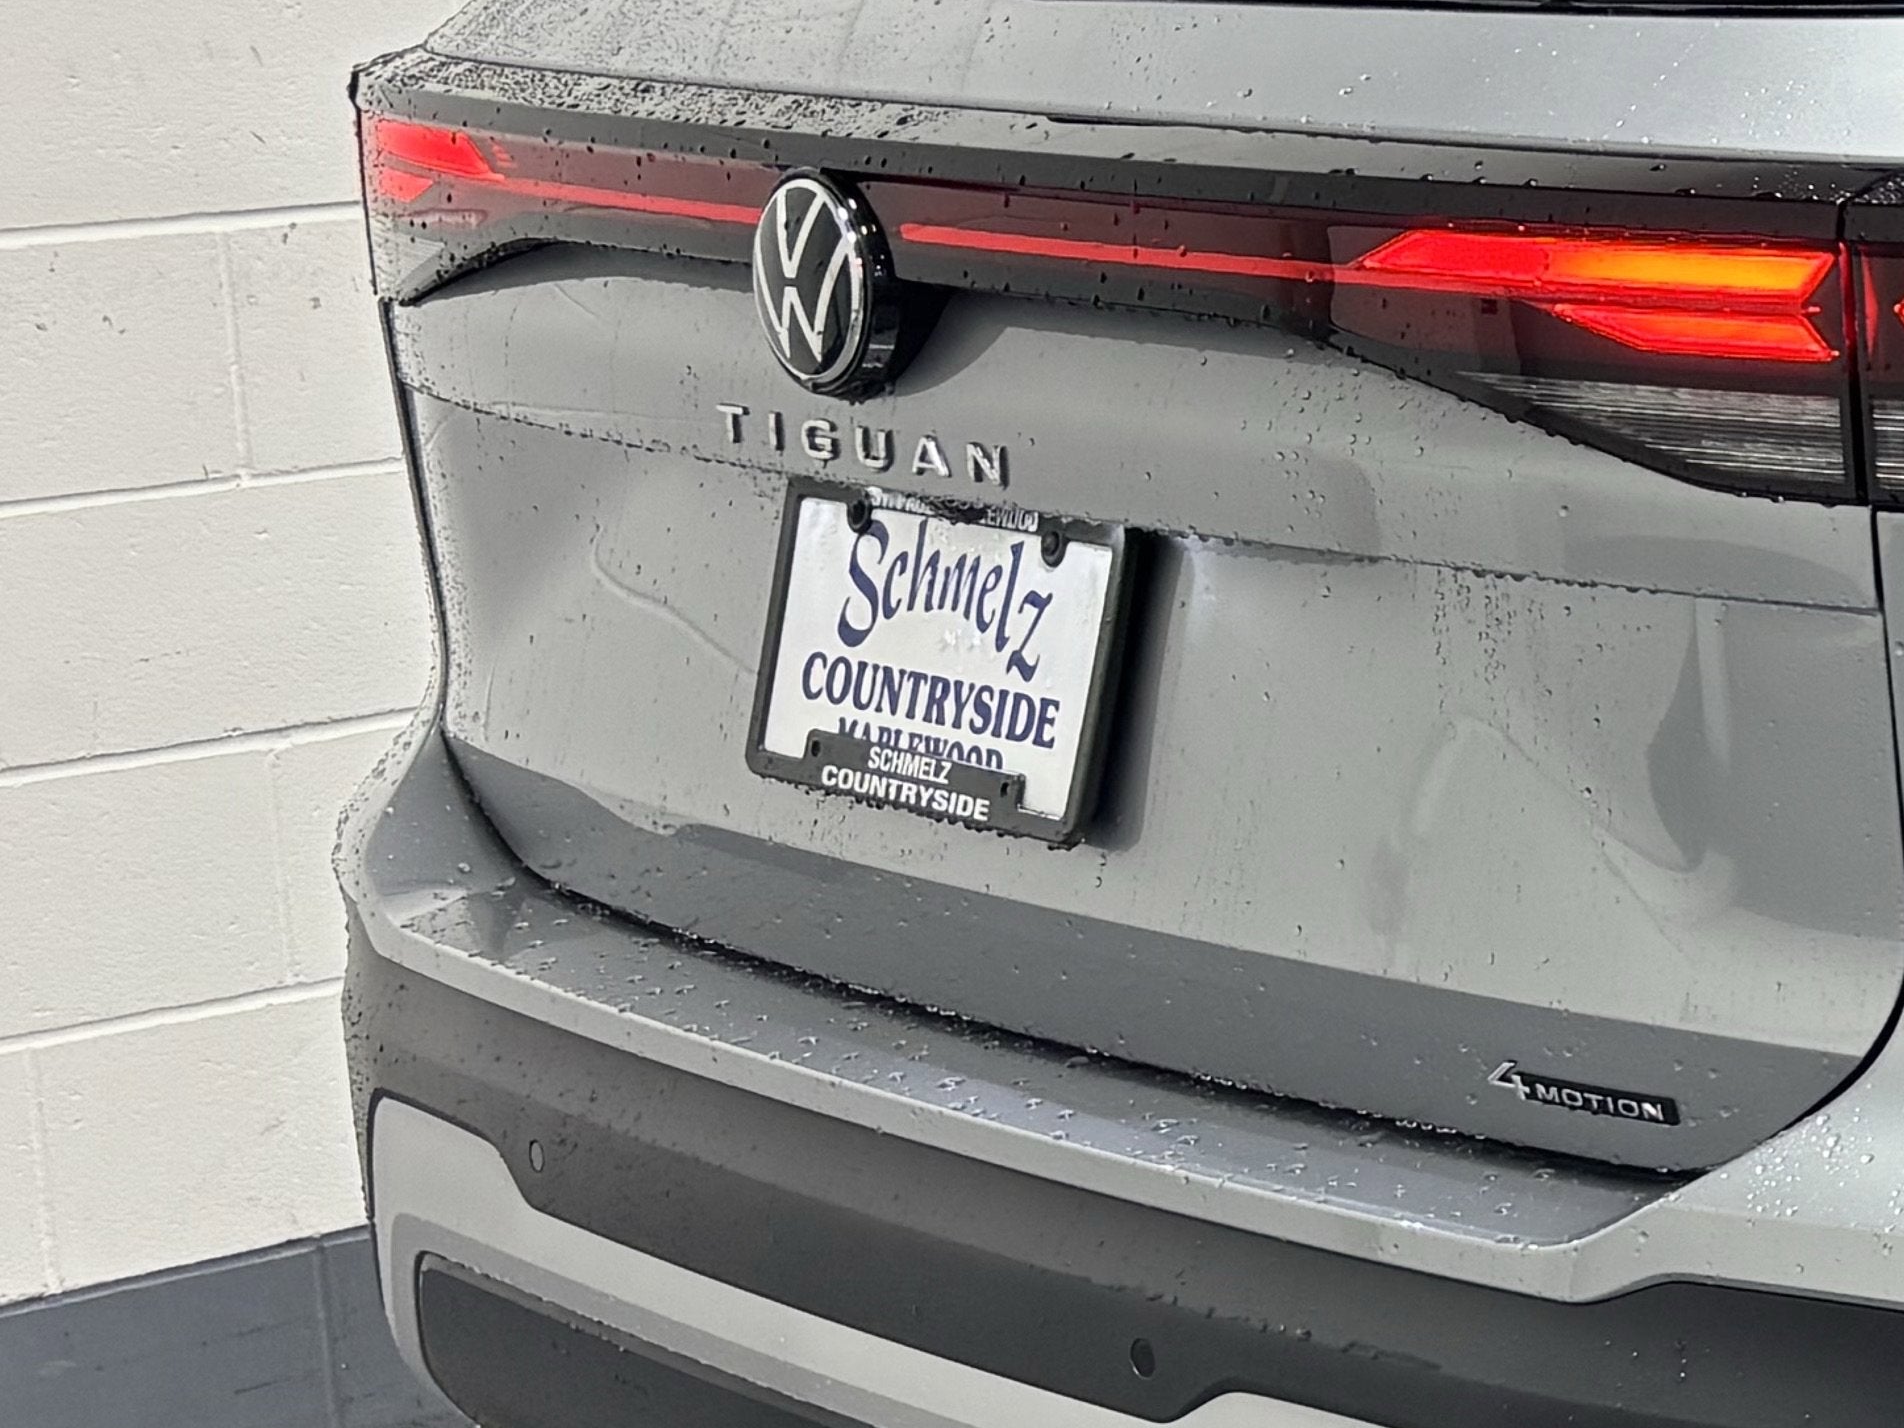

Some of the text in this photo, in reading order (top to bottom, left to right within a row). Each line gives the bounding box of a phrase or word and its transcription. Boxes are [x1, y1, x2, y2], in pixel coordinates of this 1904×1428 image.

[716, 403, 1007, 486] TIGUAN
[837, 517, 1053, 683] Schmelz
[801, 652, 1060, 749] COUNTRYSIDE
[821, 765, 990, 822] COUNTRYSIDE
[867, 746, 953, 785] SCHMELZ
[1487, 1060, 1665, 1122] 4MOTION
